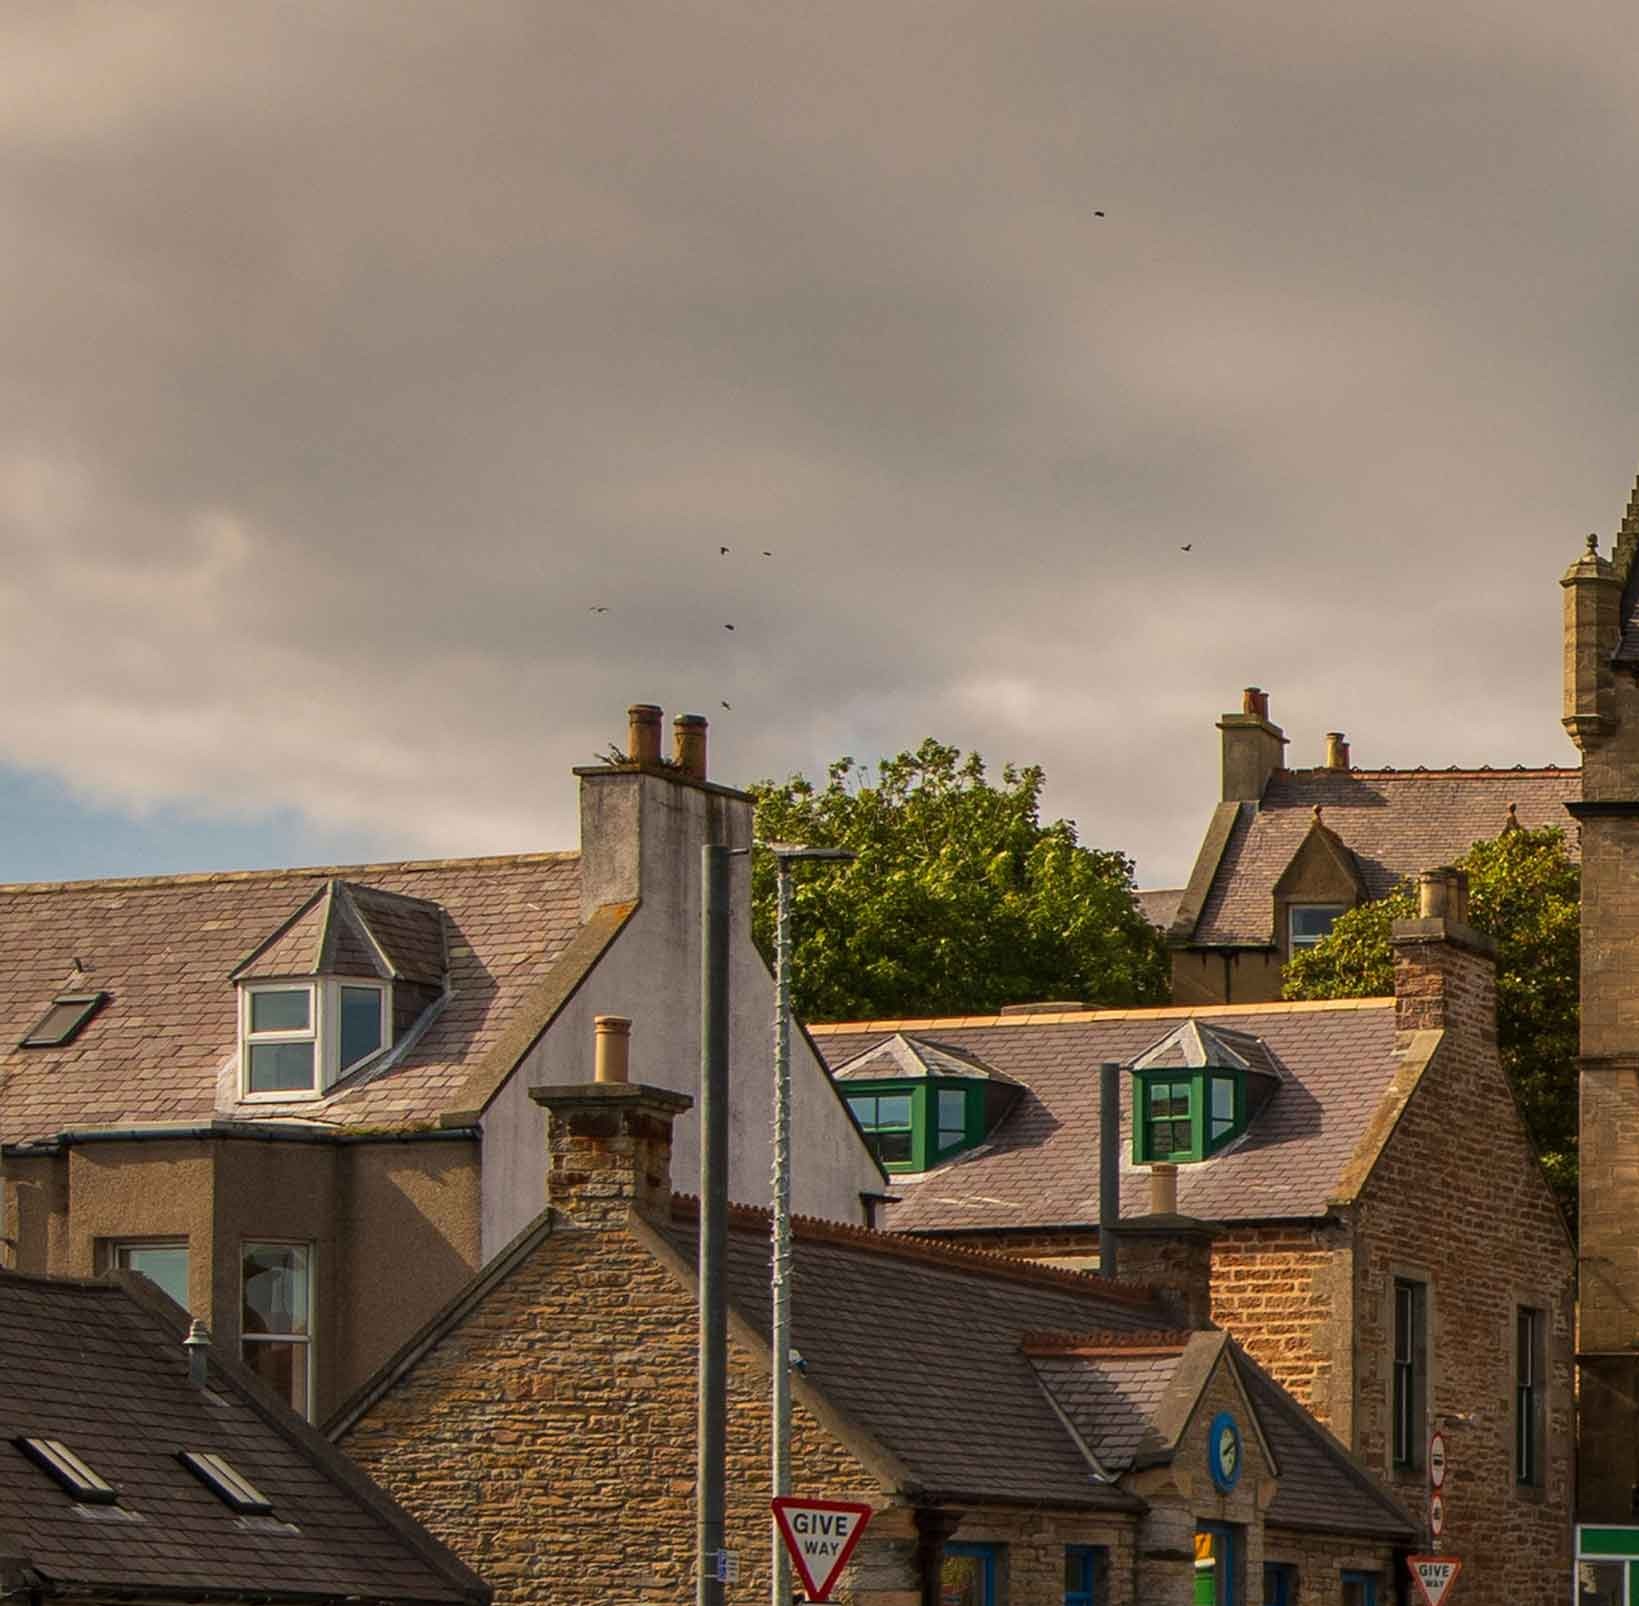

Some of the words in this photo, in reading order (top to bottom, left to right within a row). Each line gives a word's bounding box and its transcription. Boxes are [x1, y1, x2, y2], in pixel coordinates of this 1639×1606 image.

[793, 1513, 848, 1536] GIVE
[804, 1541, 840, 1556] WAY
[1418, 1564, 1449, 1576] GIVE
